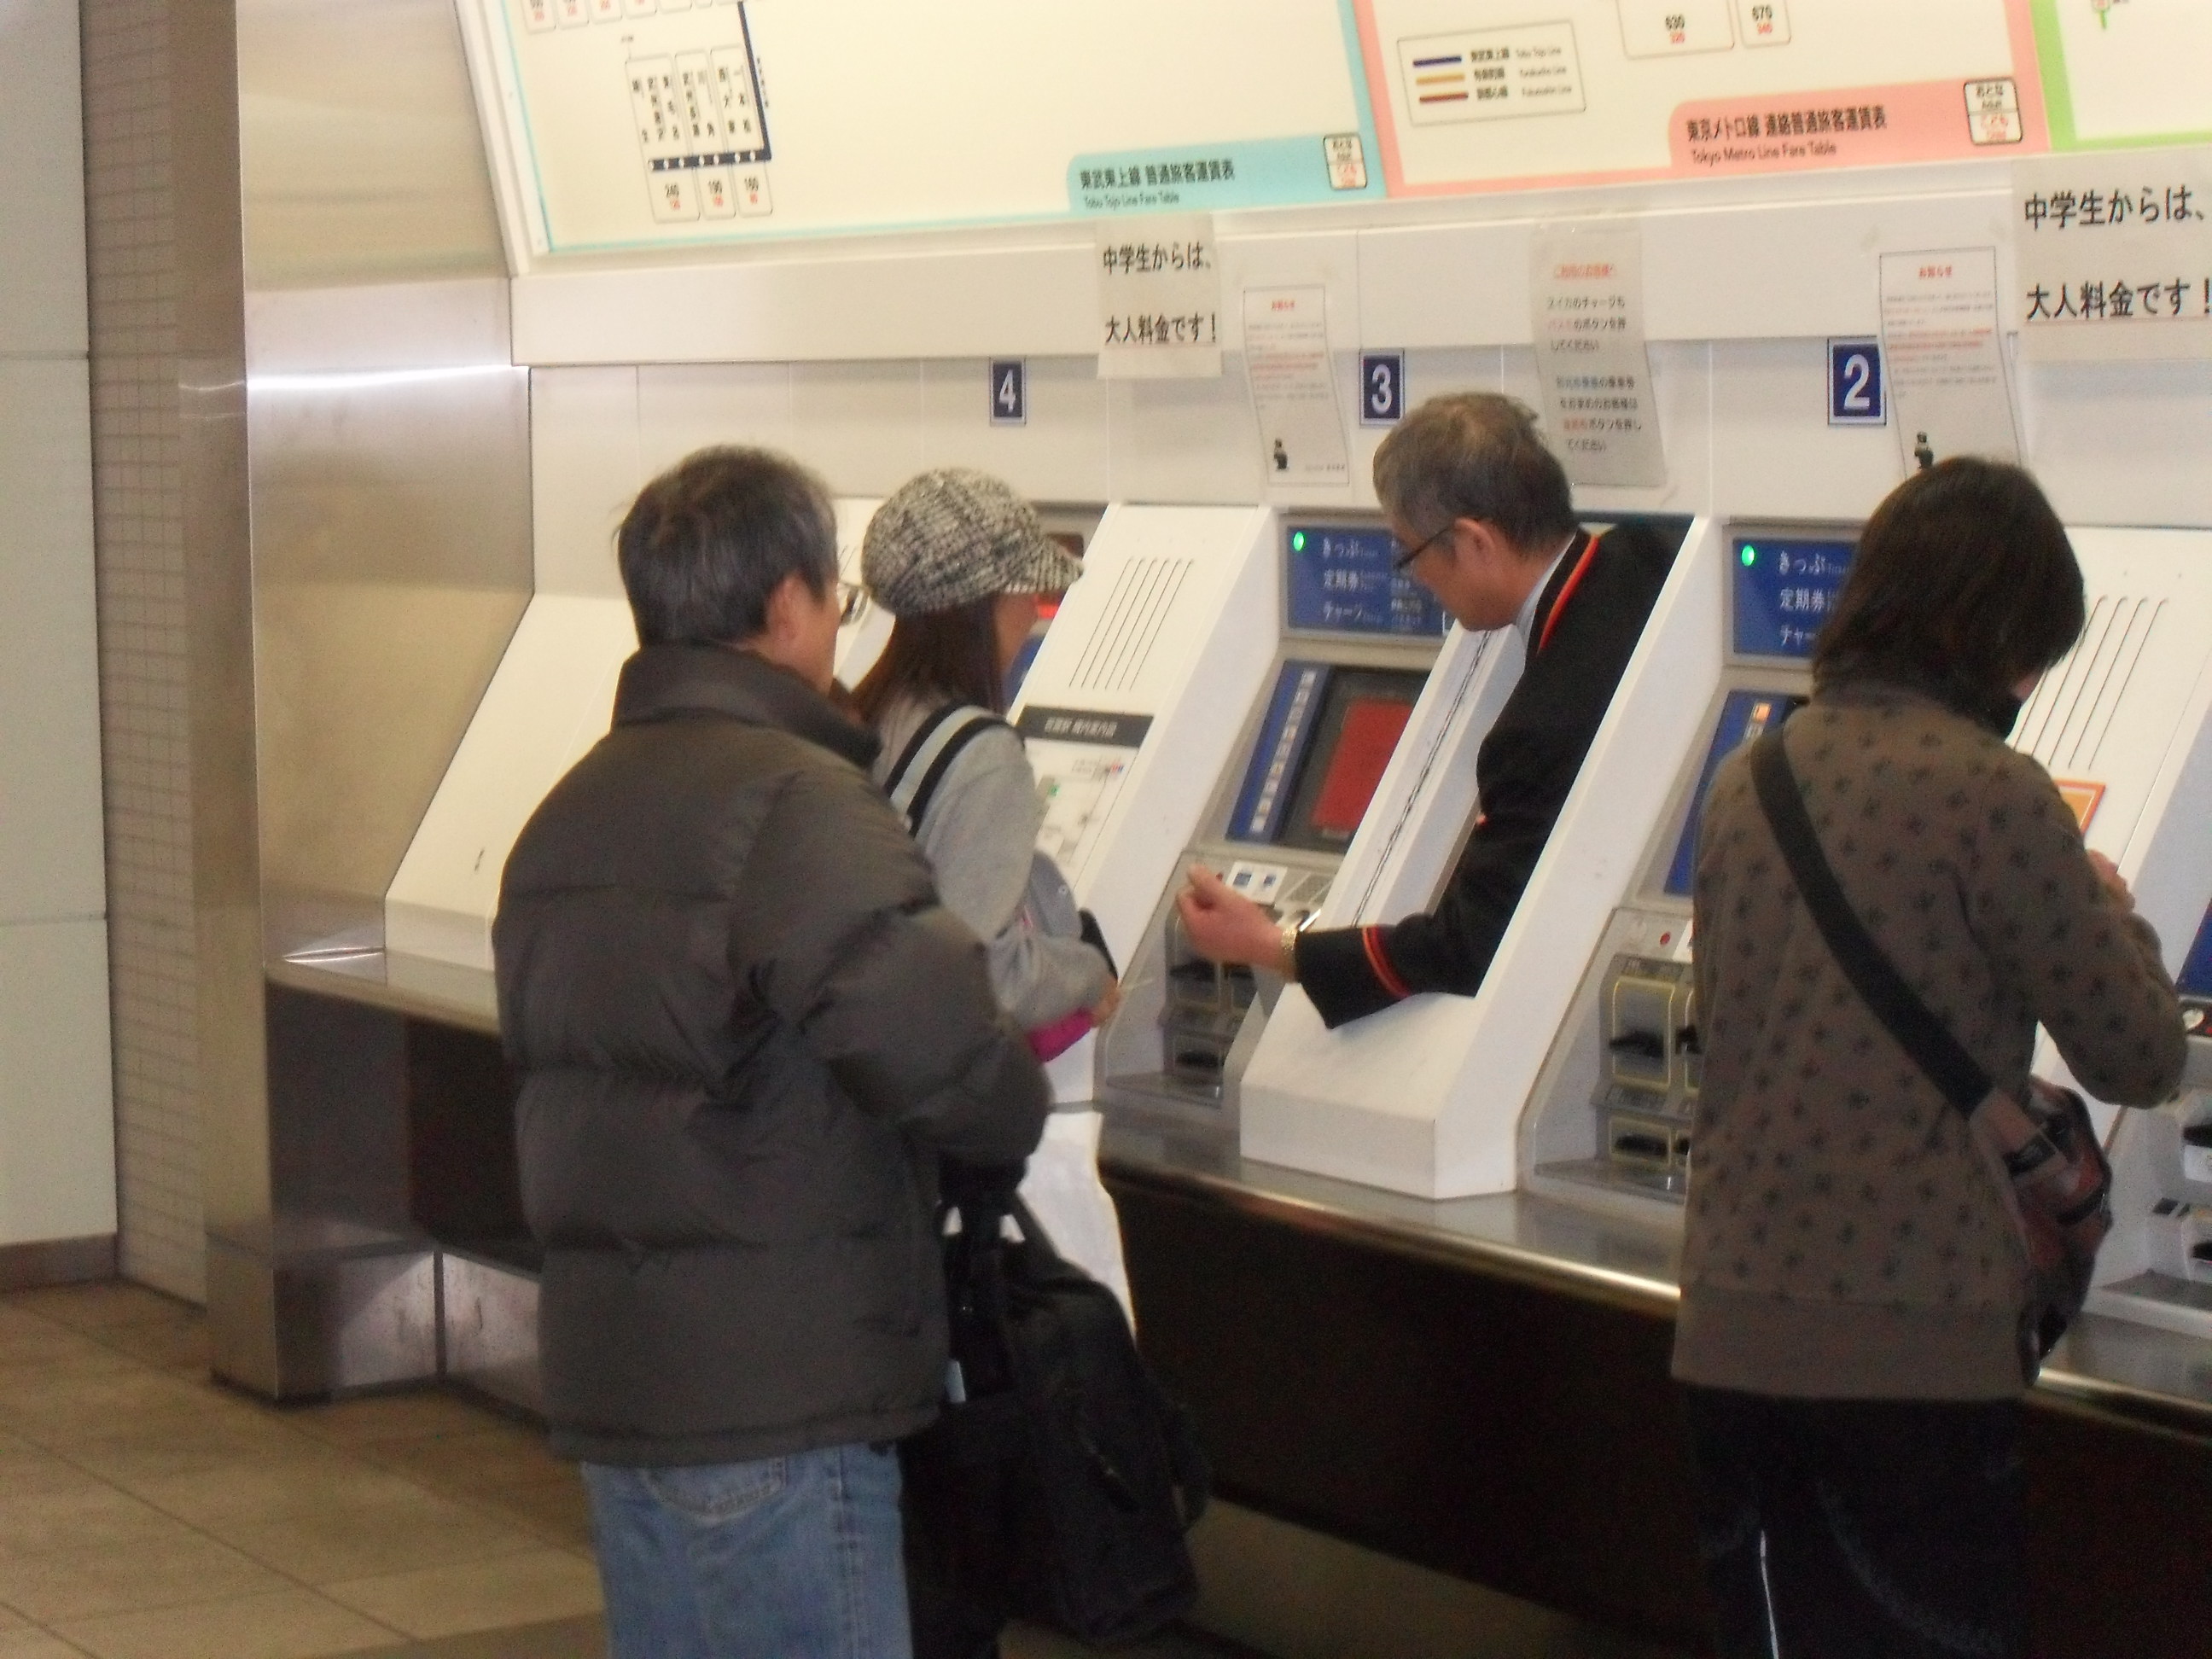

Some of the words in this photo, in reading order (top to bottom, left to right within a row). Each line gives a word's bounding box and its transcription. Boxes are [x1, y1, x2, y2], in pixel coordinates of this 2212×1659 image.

[1687, 114, 1760, 142] 東京メトロ線
[1691, 148, 1720, 167] Tokyo
[1724, 147, 1755, 161] Metro
[1758, 144, 1779, 160] Line
[1782, 141, 1806, 157] Fare
[1807, 139, 1837, 155] Table
[2024, 183, 2205, 232] 中学生からは、
[1103, 242, 1211, 275] 中学生からは、
[2026, 276, 2211, 321] 大人料金です！
[1105, 311, 1217, 346] 大人料金です！
[999, 369, 1016, 413] 4
[1371, 364, 1393, 415] 3
[1843, 353, 1871, 410] 2
[1779, 549, 1826, 576] きっぷ
[1779, 586, 1825, 614] 定期券
